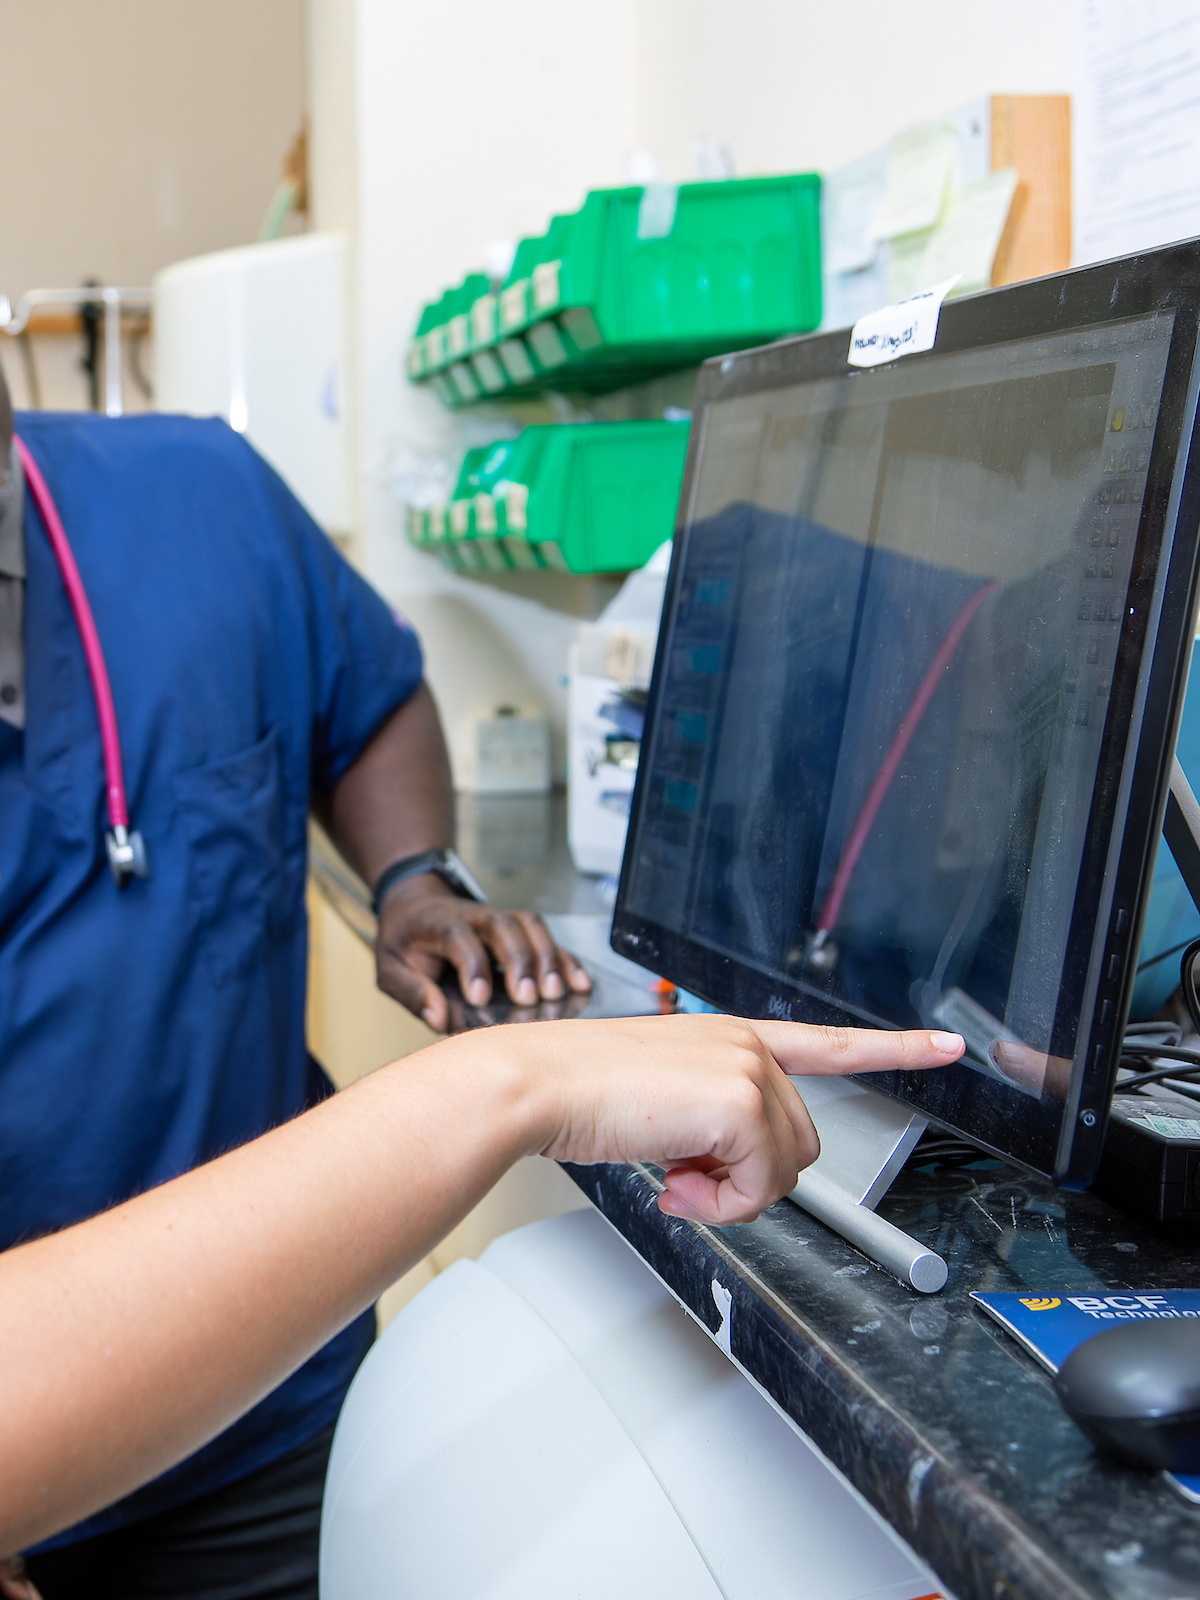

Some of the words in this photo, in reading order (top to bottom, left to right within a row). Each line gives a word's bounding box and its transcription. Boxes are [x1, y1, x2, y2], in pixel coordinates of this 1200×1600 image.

[769, 995, 792, 1020] DELL
[1066, 1295, 1168, 1310] BCF
[1084, 1309, 1200, 1319] Technolo
